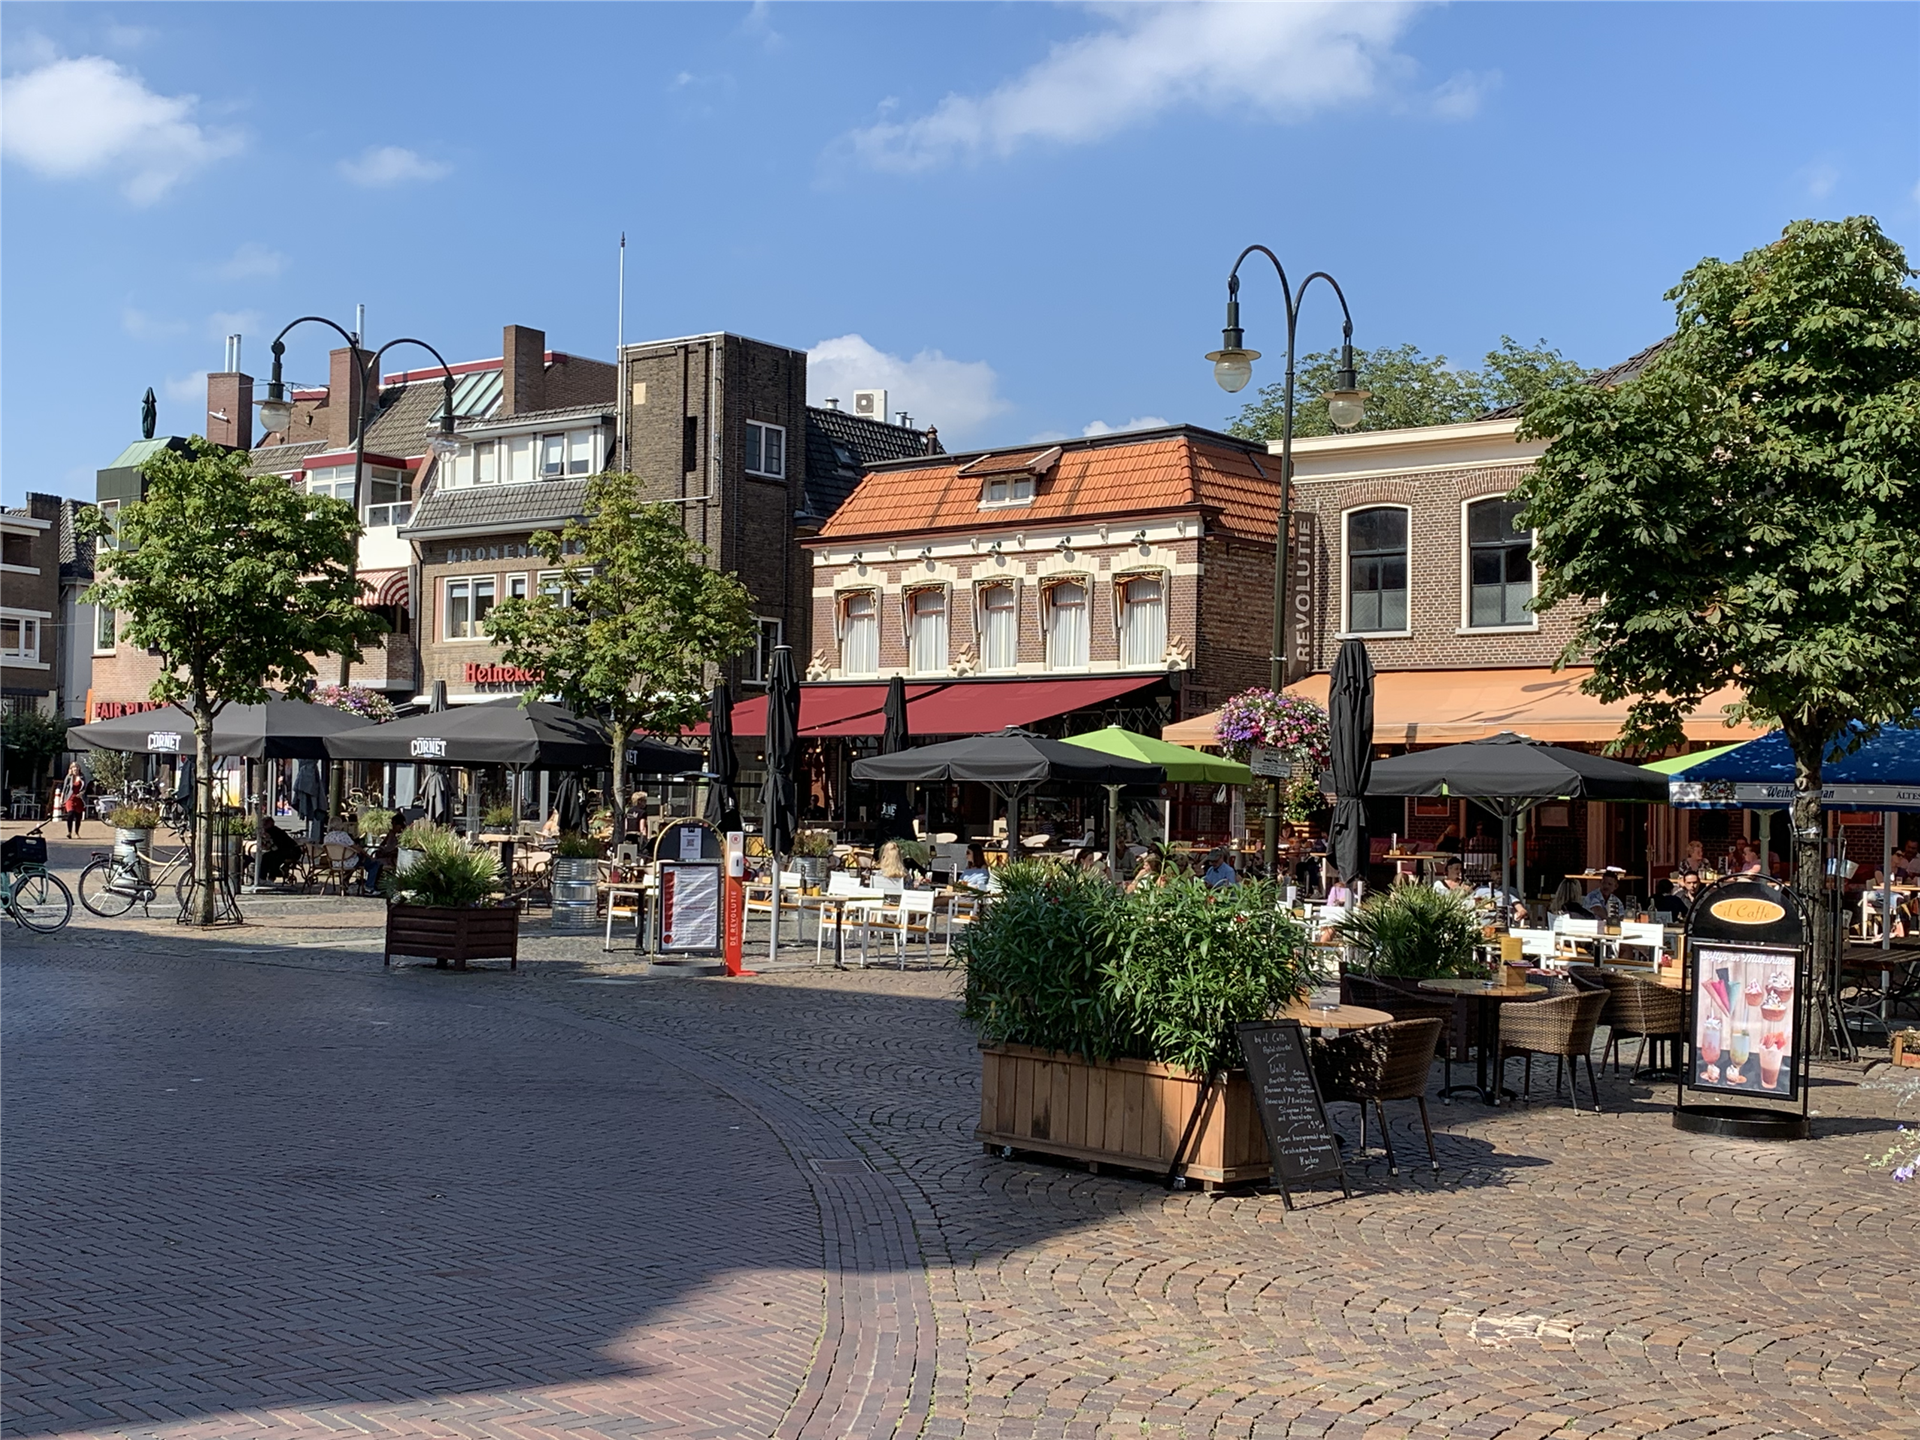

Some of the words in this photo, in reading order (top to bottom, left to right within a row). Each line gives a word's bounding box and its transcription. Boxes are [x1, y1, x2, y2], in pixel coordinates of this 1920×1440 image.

[1295, 520, 1311, 662] REVOLUTIE
[95, 702, 122, 718] FAIR
[147, 734, 182, 751] CORNET
[411, 740, 447, 757] CORNET
